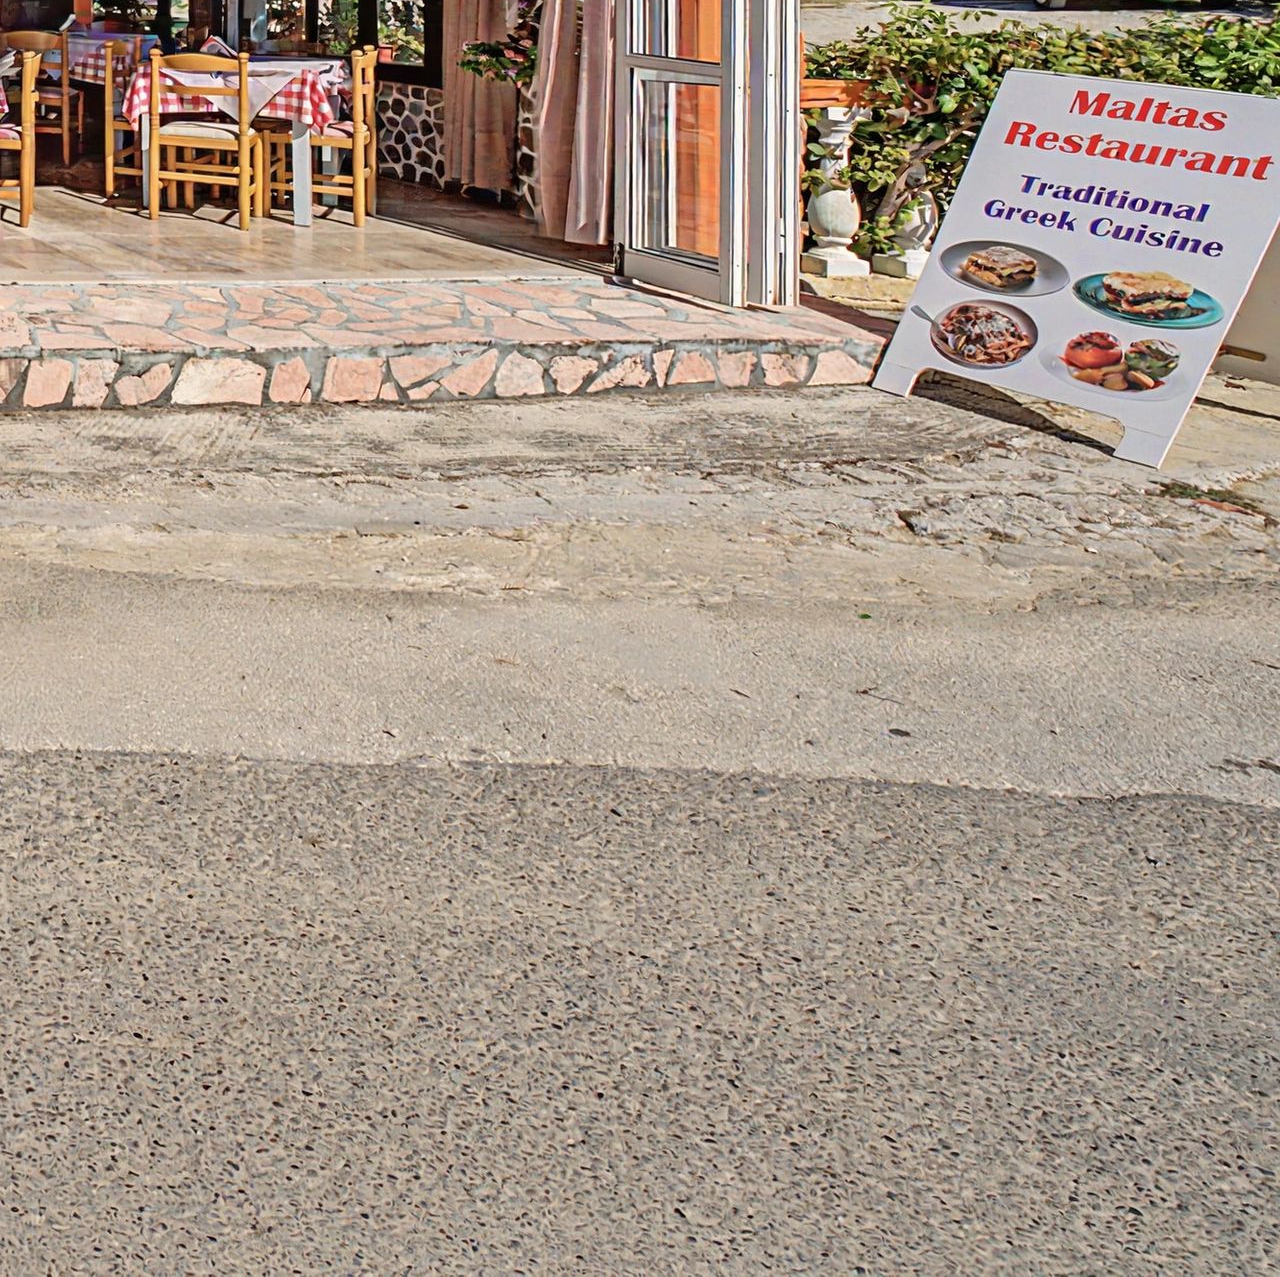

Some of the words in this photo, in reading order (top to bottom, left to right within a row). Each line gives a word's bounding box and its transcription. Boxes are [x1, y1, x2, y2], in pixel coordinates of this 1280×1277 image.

[1069, 90, 1228, 132] Maltas
[1004, 121, 1274, 180] Restaurant
[1021, 175, 1210, 222] Traditional
[984, 199, 1077, 232] Greek
[1090, 217, 1224, 258] Cuisine
